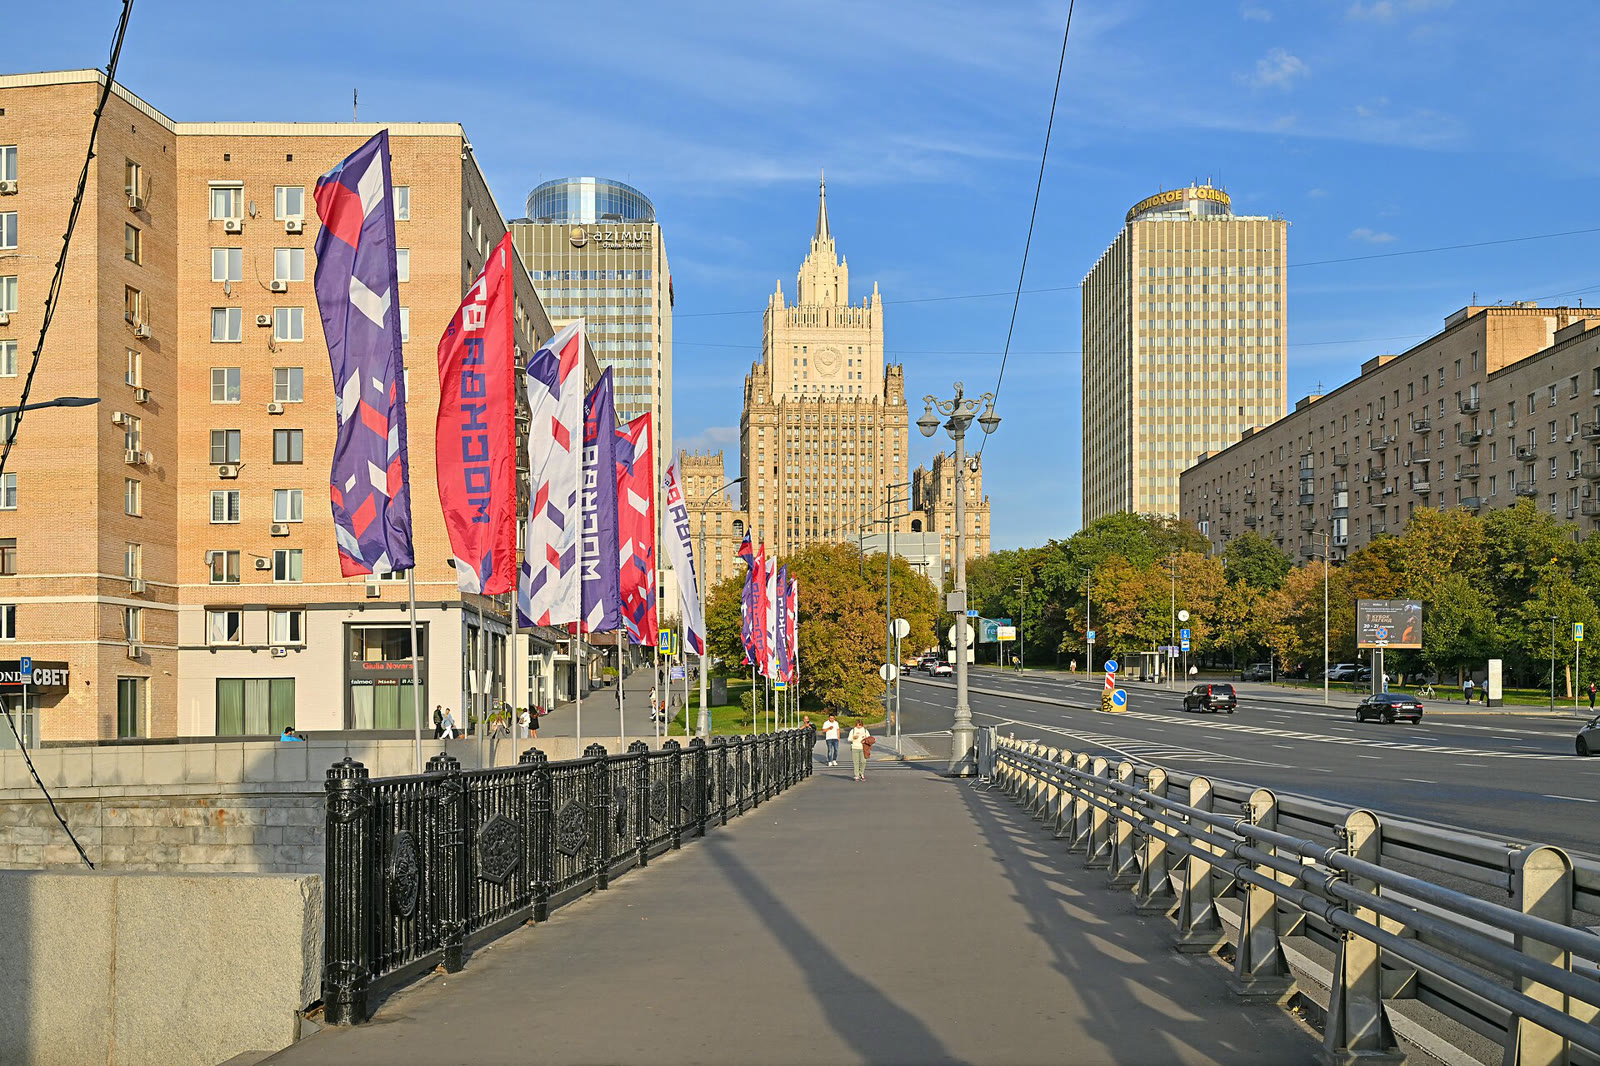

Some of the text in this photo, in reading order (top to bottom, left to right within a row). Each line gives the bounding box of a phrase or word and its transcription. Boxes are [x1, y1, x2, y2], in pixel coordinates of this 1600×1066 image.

[1189, 188, 1230, 205] КОЛЬЦО
[362, 662, 385, 670] Giulia
[33, 668, 68, 685] СВЕТ
